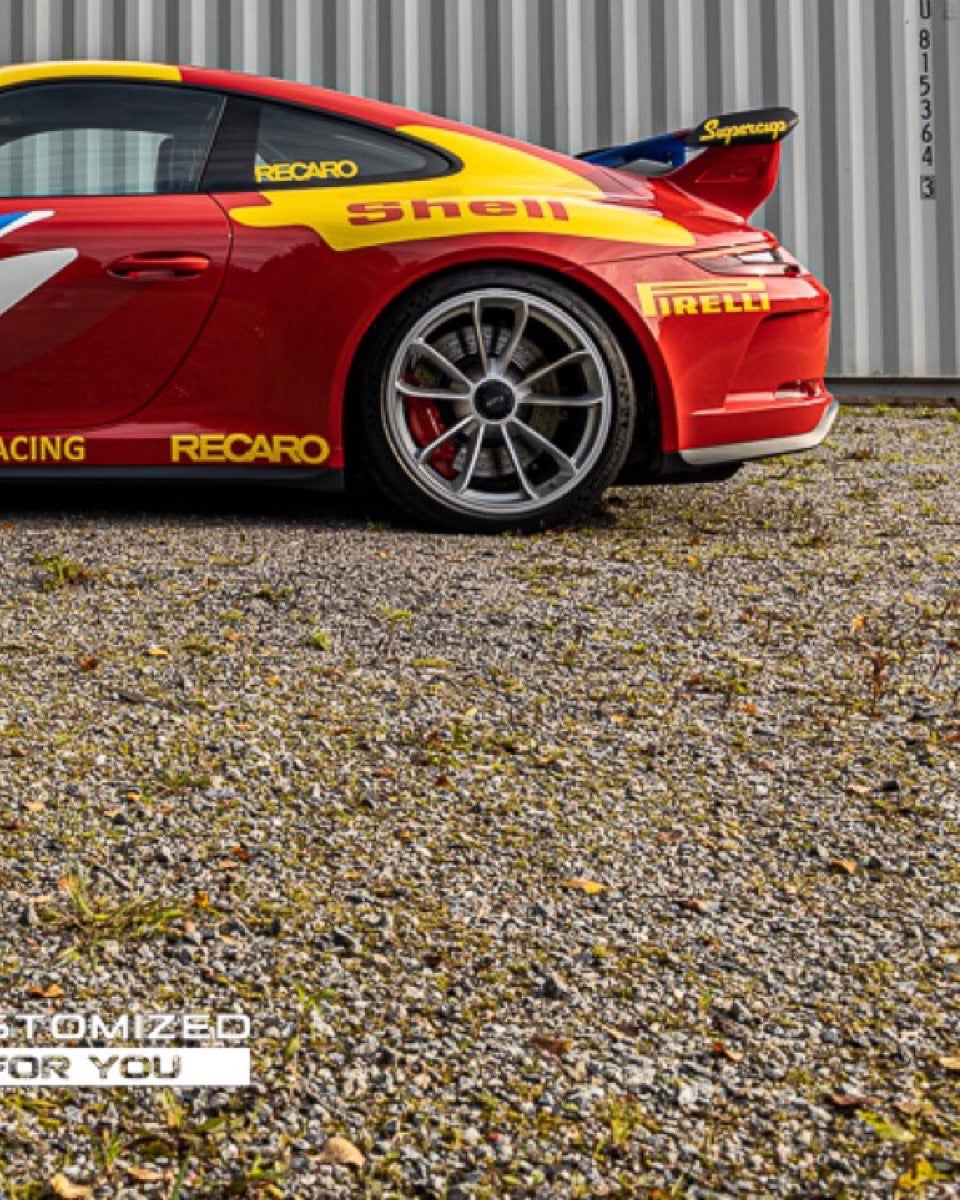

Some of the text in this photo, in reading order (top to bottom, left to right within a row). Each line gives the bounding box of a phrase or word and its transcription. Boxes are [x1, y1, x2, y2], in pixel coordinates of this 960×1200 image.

[254, 160, 358, 183] RECARO
[920, 176, 936, 199] 3
[346, 200, 570, 227] Shell
[637, 279, 771, 318] PIRELLI
[170, 433, 331, 464] RECARO
